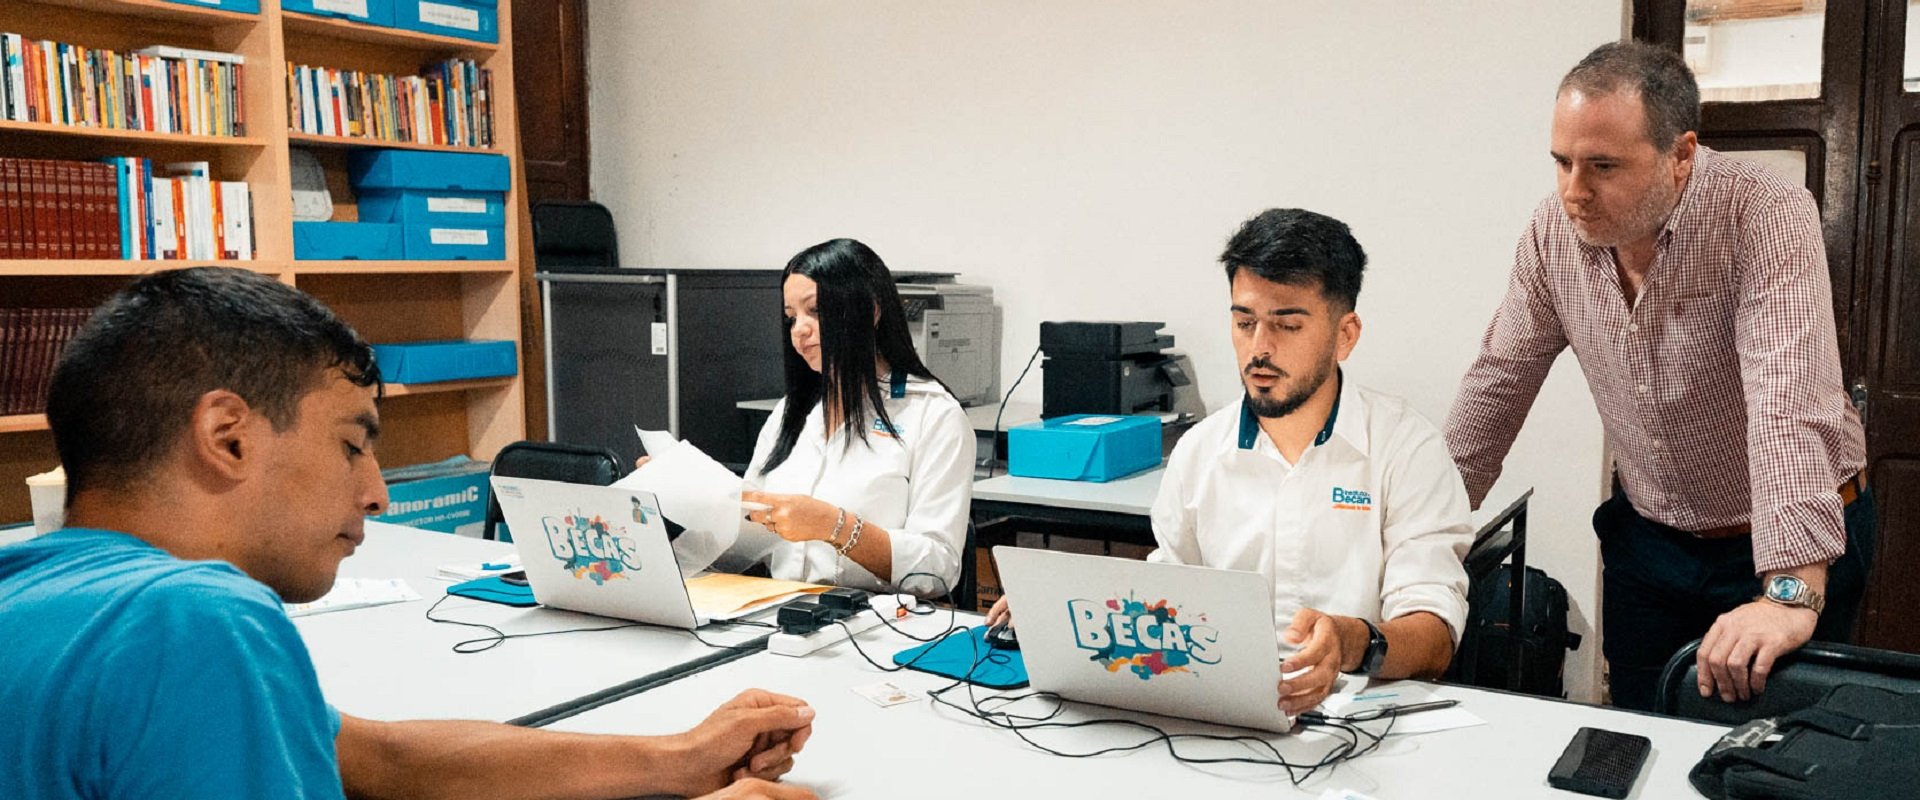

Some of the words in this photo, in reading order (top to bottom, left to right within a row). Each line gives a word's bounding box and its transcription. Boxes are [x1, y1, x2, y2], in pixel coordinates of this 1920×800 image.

[380, 486, 479, 517] anoramiC
[542, 516, 642, 570] BECAS
[1067, 599, 1222, 665] BECAS
